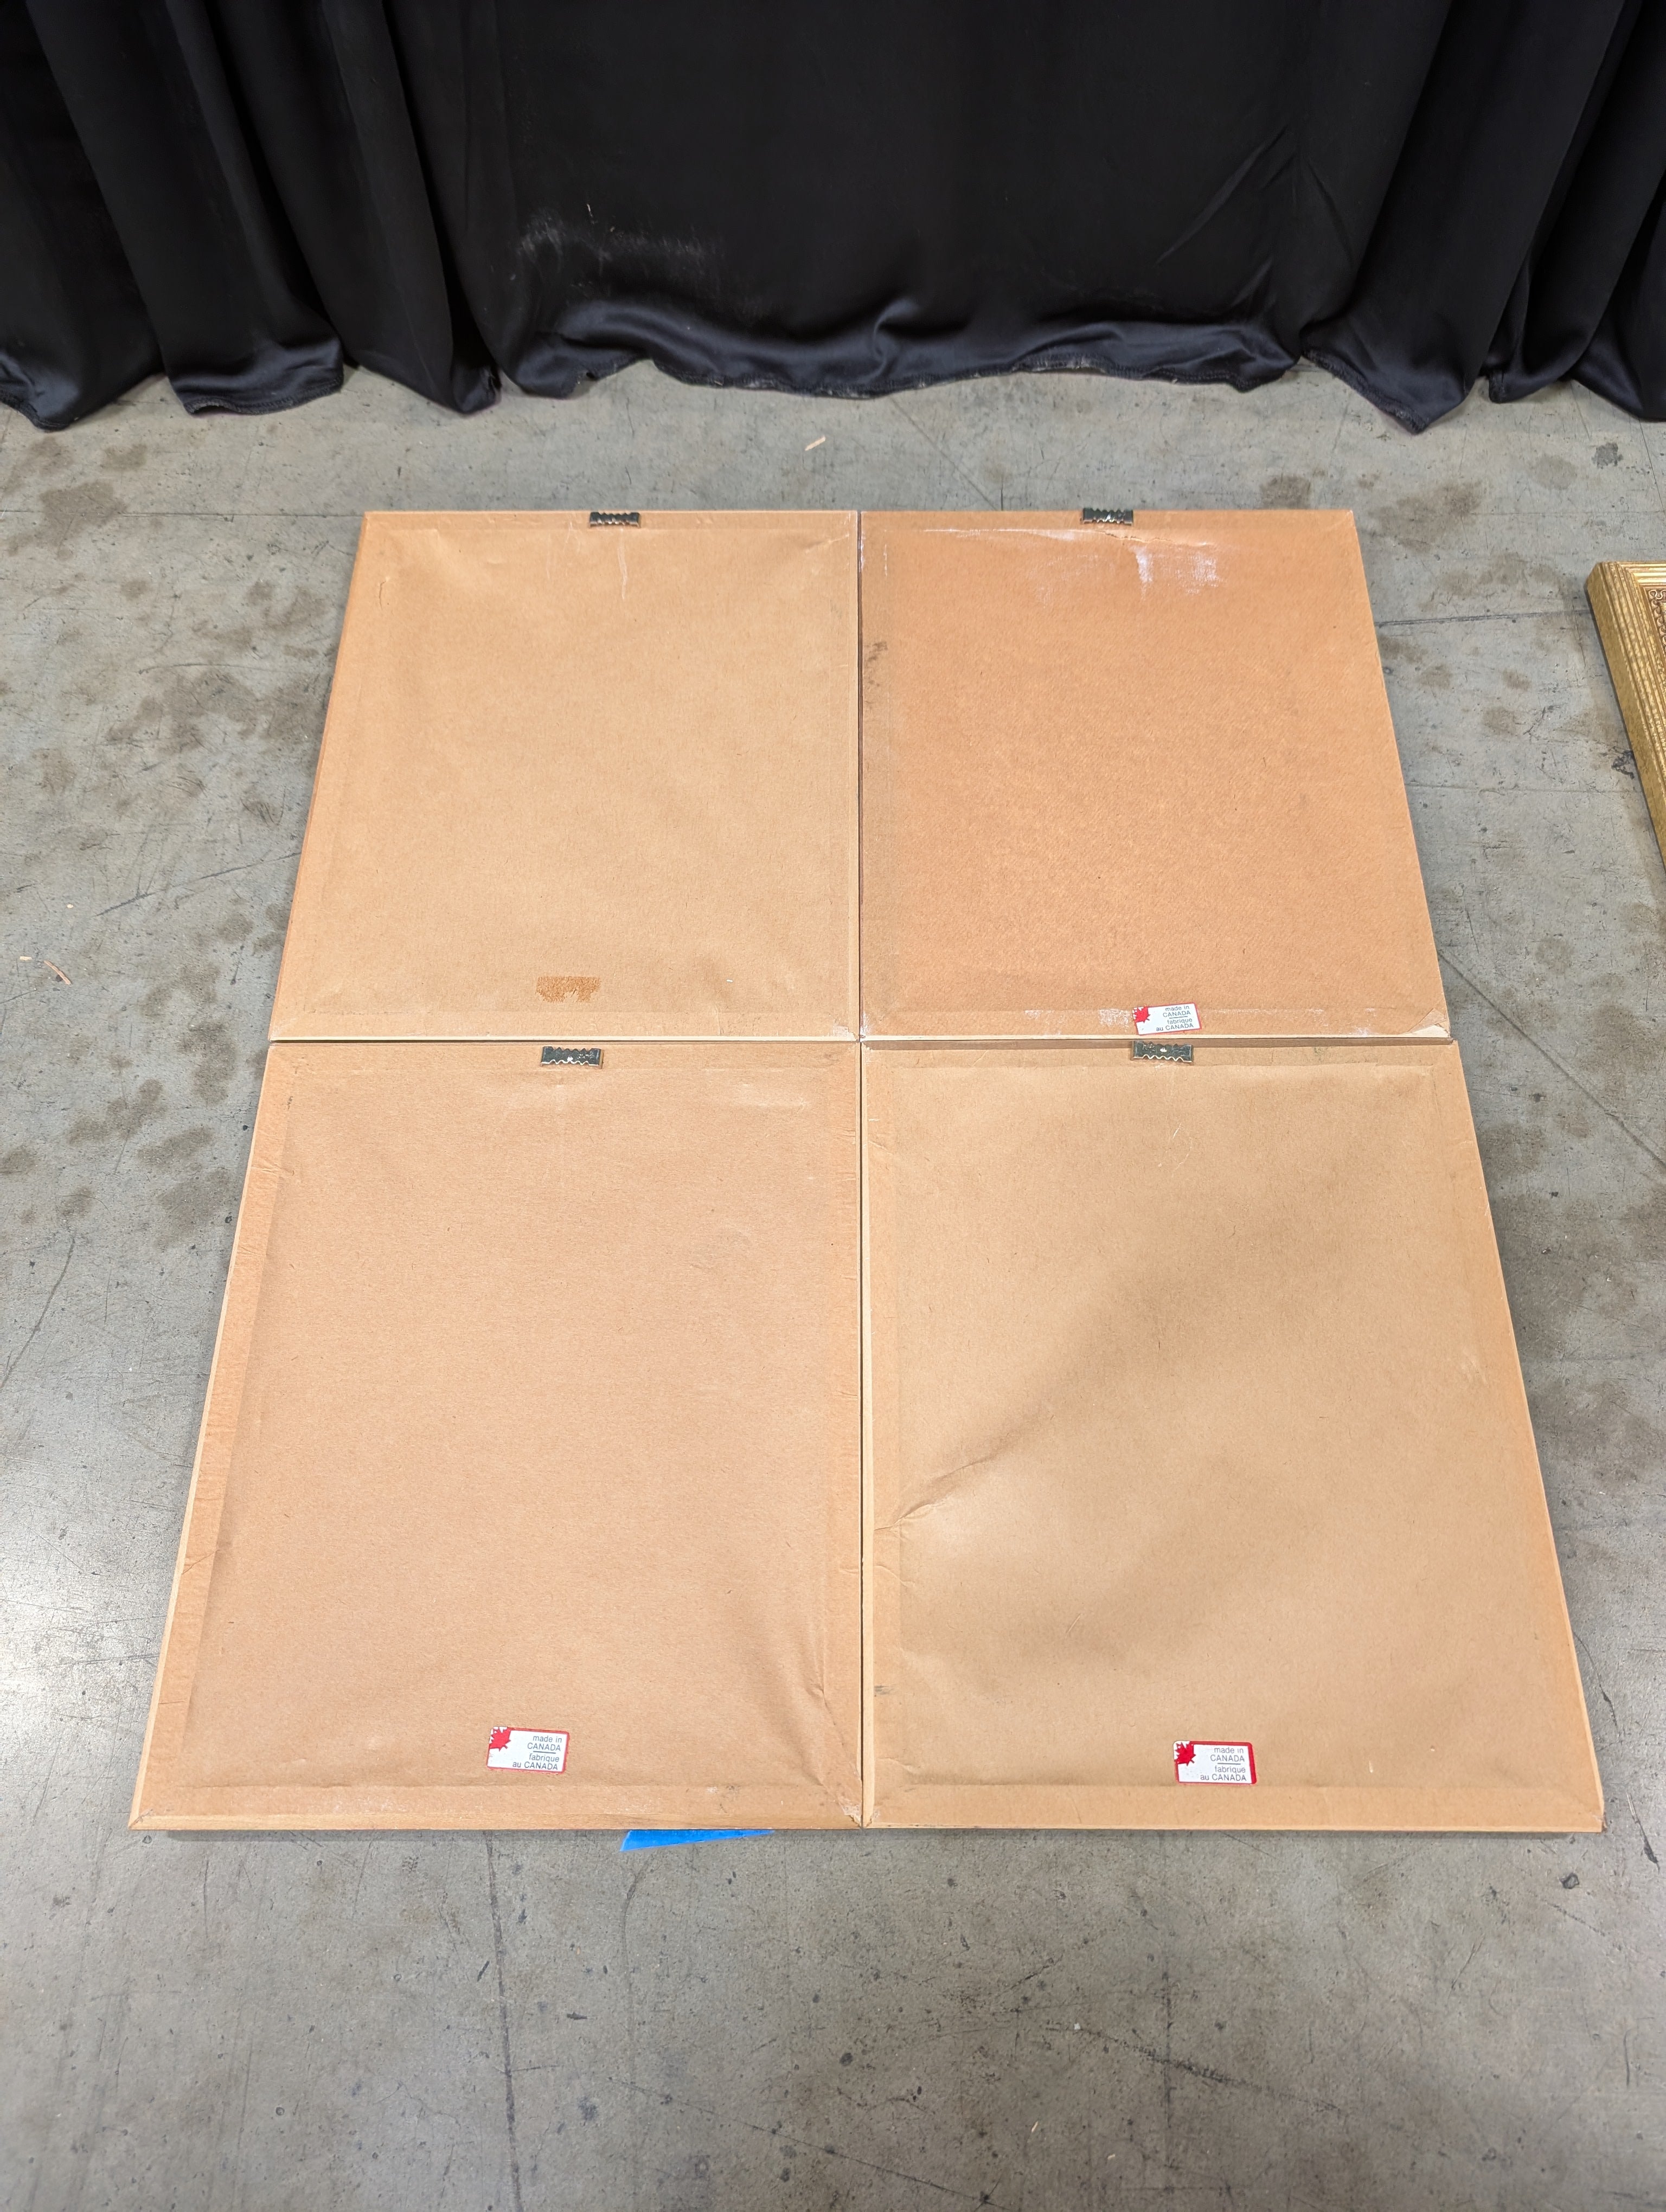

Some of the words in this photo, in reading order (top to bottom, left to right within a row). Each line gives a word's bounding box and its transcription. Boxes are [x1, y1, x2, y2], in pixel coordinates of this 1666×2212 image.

[527, 1742, 561, 1751] CANADA
[529, 1753, 560, 1762] fabrique
[524, 1761, 558, 1770] CANADA
[1214, 1765, 1246, 1774] fabrique
